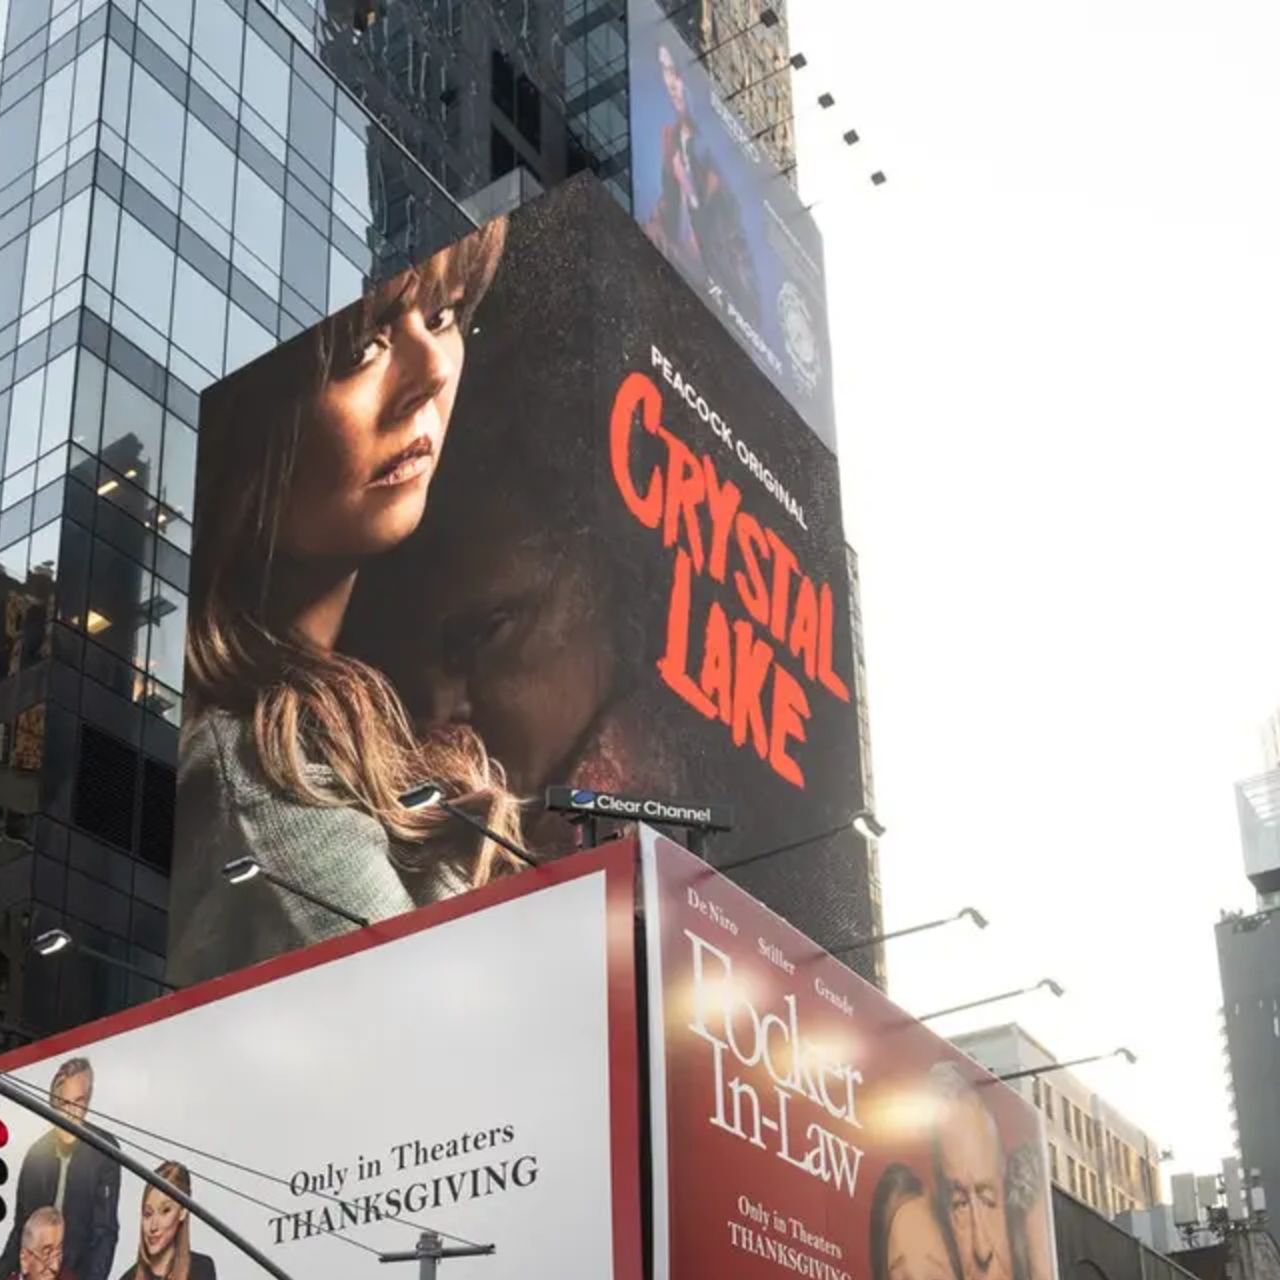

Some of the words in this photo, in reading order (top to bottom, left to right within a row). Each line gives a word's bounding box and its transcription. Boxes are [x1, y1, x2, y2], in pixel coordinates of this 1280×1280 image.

[651, 344, 734, 450] PEACOCK
[736, 440, 808, 531] ORIGINAL
[610, 372, 849, 702] CRYSTAL
[657, 546, 811, 789] LAKE
[597, 795, 641, 813] Clear
[643, 801, 711, 821] Channel
[708, 900, 739, 935] Niro
[758, 936, 796, 975] Stiller
[814, 978, 854, 1016] Grande
[684, 928, 863, 1129] Focker
[290, 1163, 348, 1196] Only
[358, 1155, 381, 1180] in
[391, 1124, 515, 1172] Theaters
[709, 1041, 865, 1198] In-Law
[268, 1155, 539, 1245] THANKSGIVING
[738, 1195, 769, 1231] Only
[773, 1210, 786, 1233] in
[789, 1217, 842, 1259] Theaters
